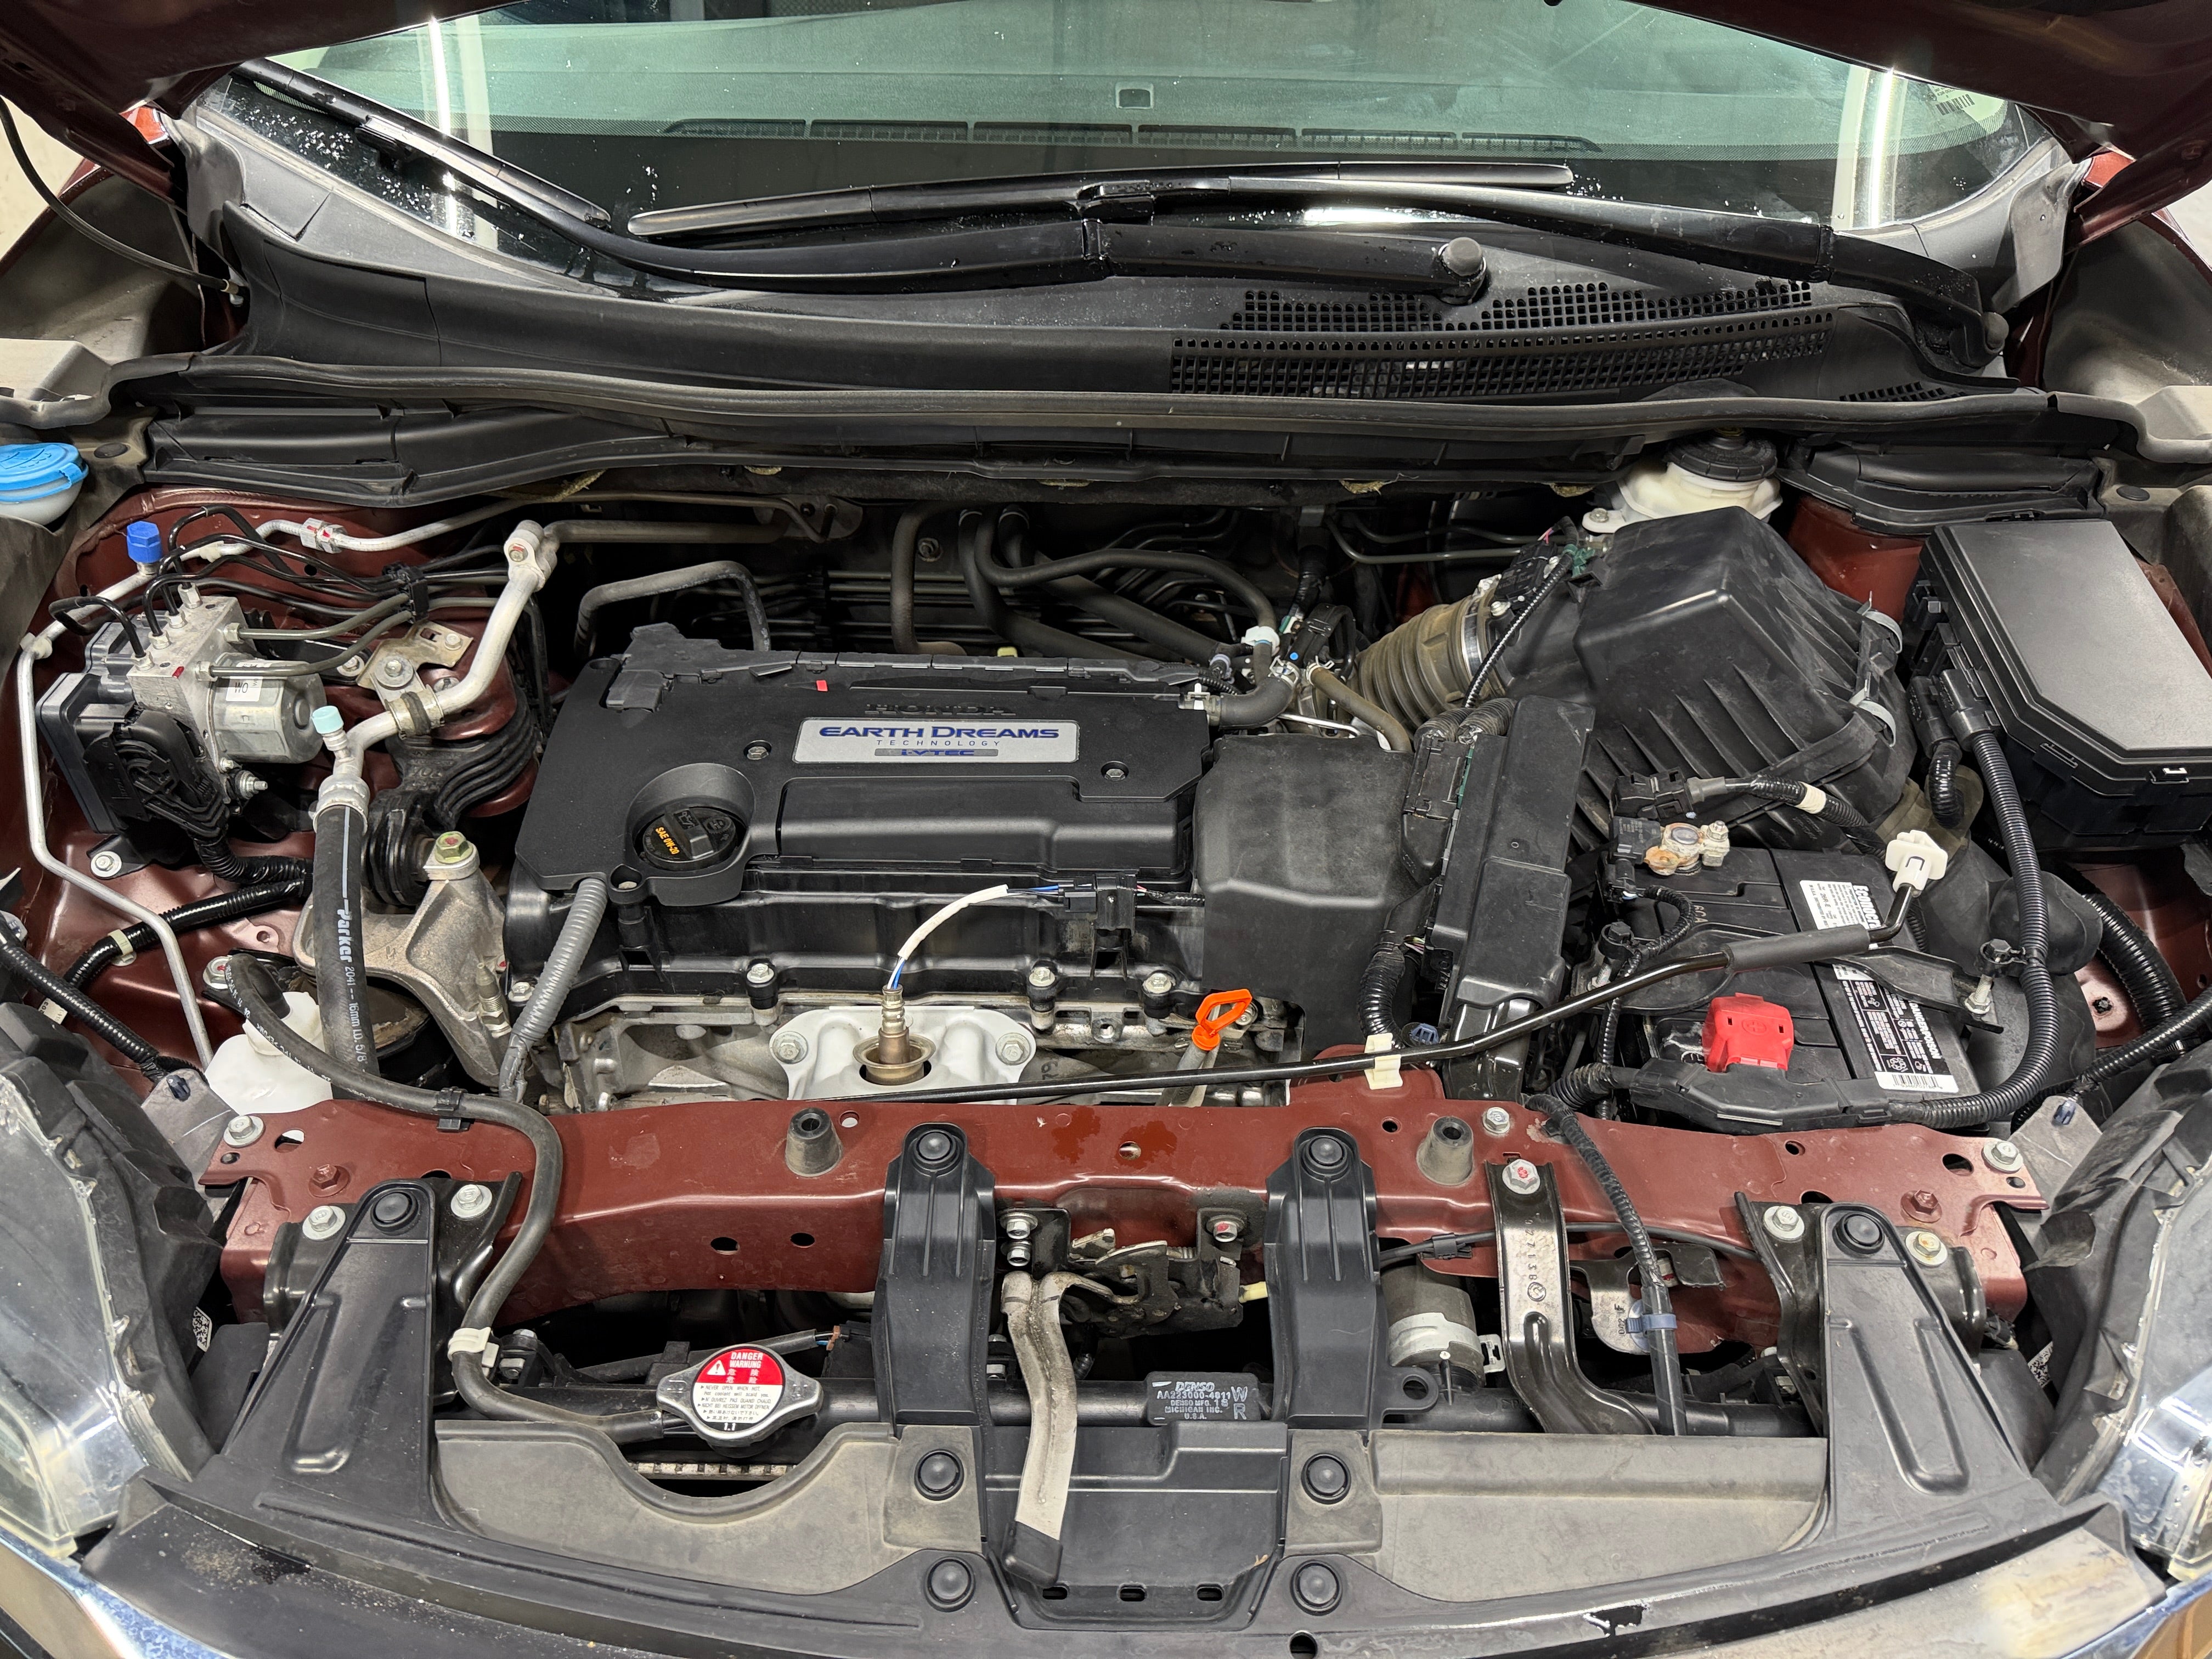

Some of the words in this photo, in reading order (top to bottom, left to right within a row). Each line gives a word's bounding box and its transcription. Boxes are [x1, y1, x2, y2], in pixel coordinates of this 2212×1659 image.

[865, 704, 1016, 716] HONDA
[820, 726, 924, 738] EARTH
[931, 726, 1059, 738] DREAMS
[656, 827, 669, 839] SAE
[663, 838, 680, 855] 0W-20
[1853, 885, 1882, 928] Econocra
[332, 909, 353, 963] Parker
[345, 966, 356, 986] 2041
[349, 1002, 361, 1029] 16mm
[729, 1360, 762, 1369] WARNUNG
[731, 1352, 764, 1361] DANGER
[1175, 1381, 1215, 1392] DENSO
[1231, 1386, 1248, 1402] W
[1234, 1403, 1247, 1420] R
[724, 1423, 736, 1431] 1.1
